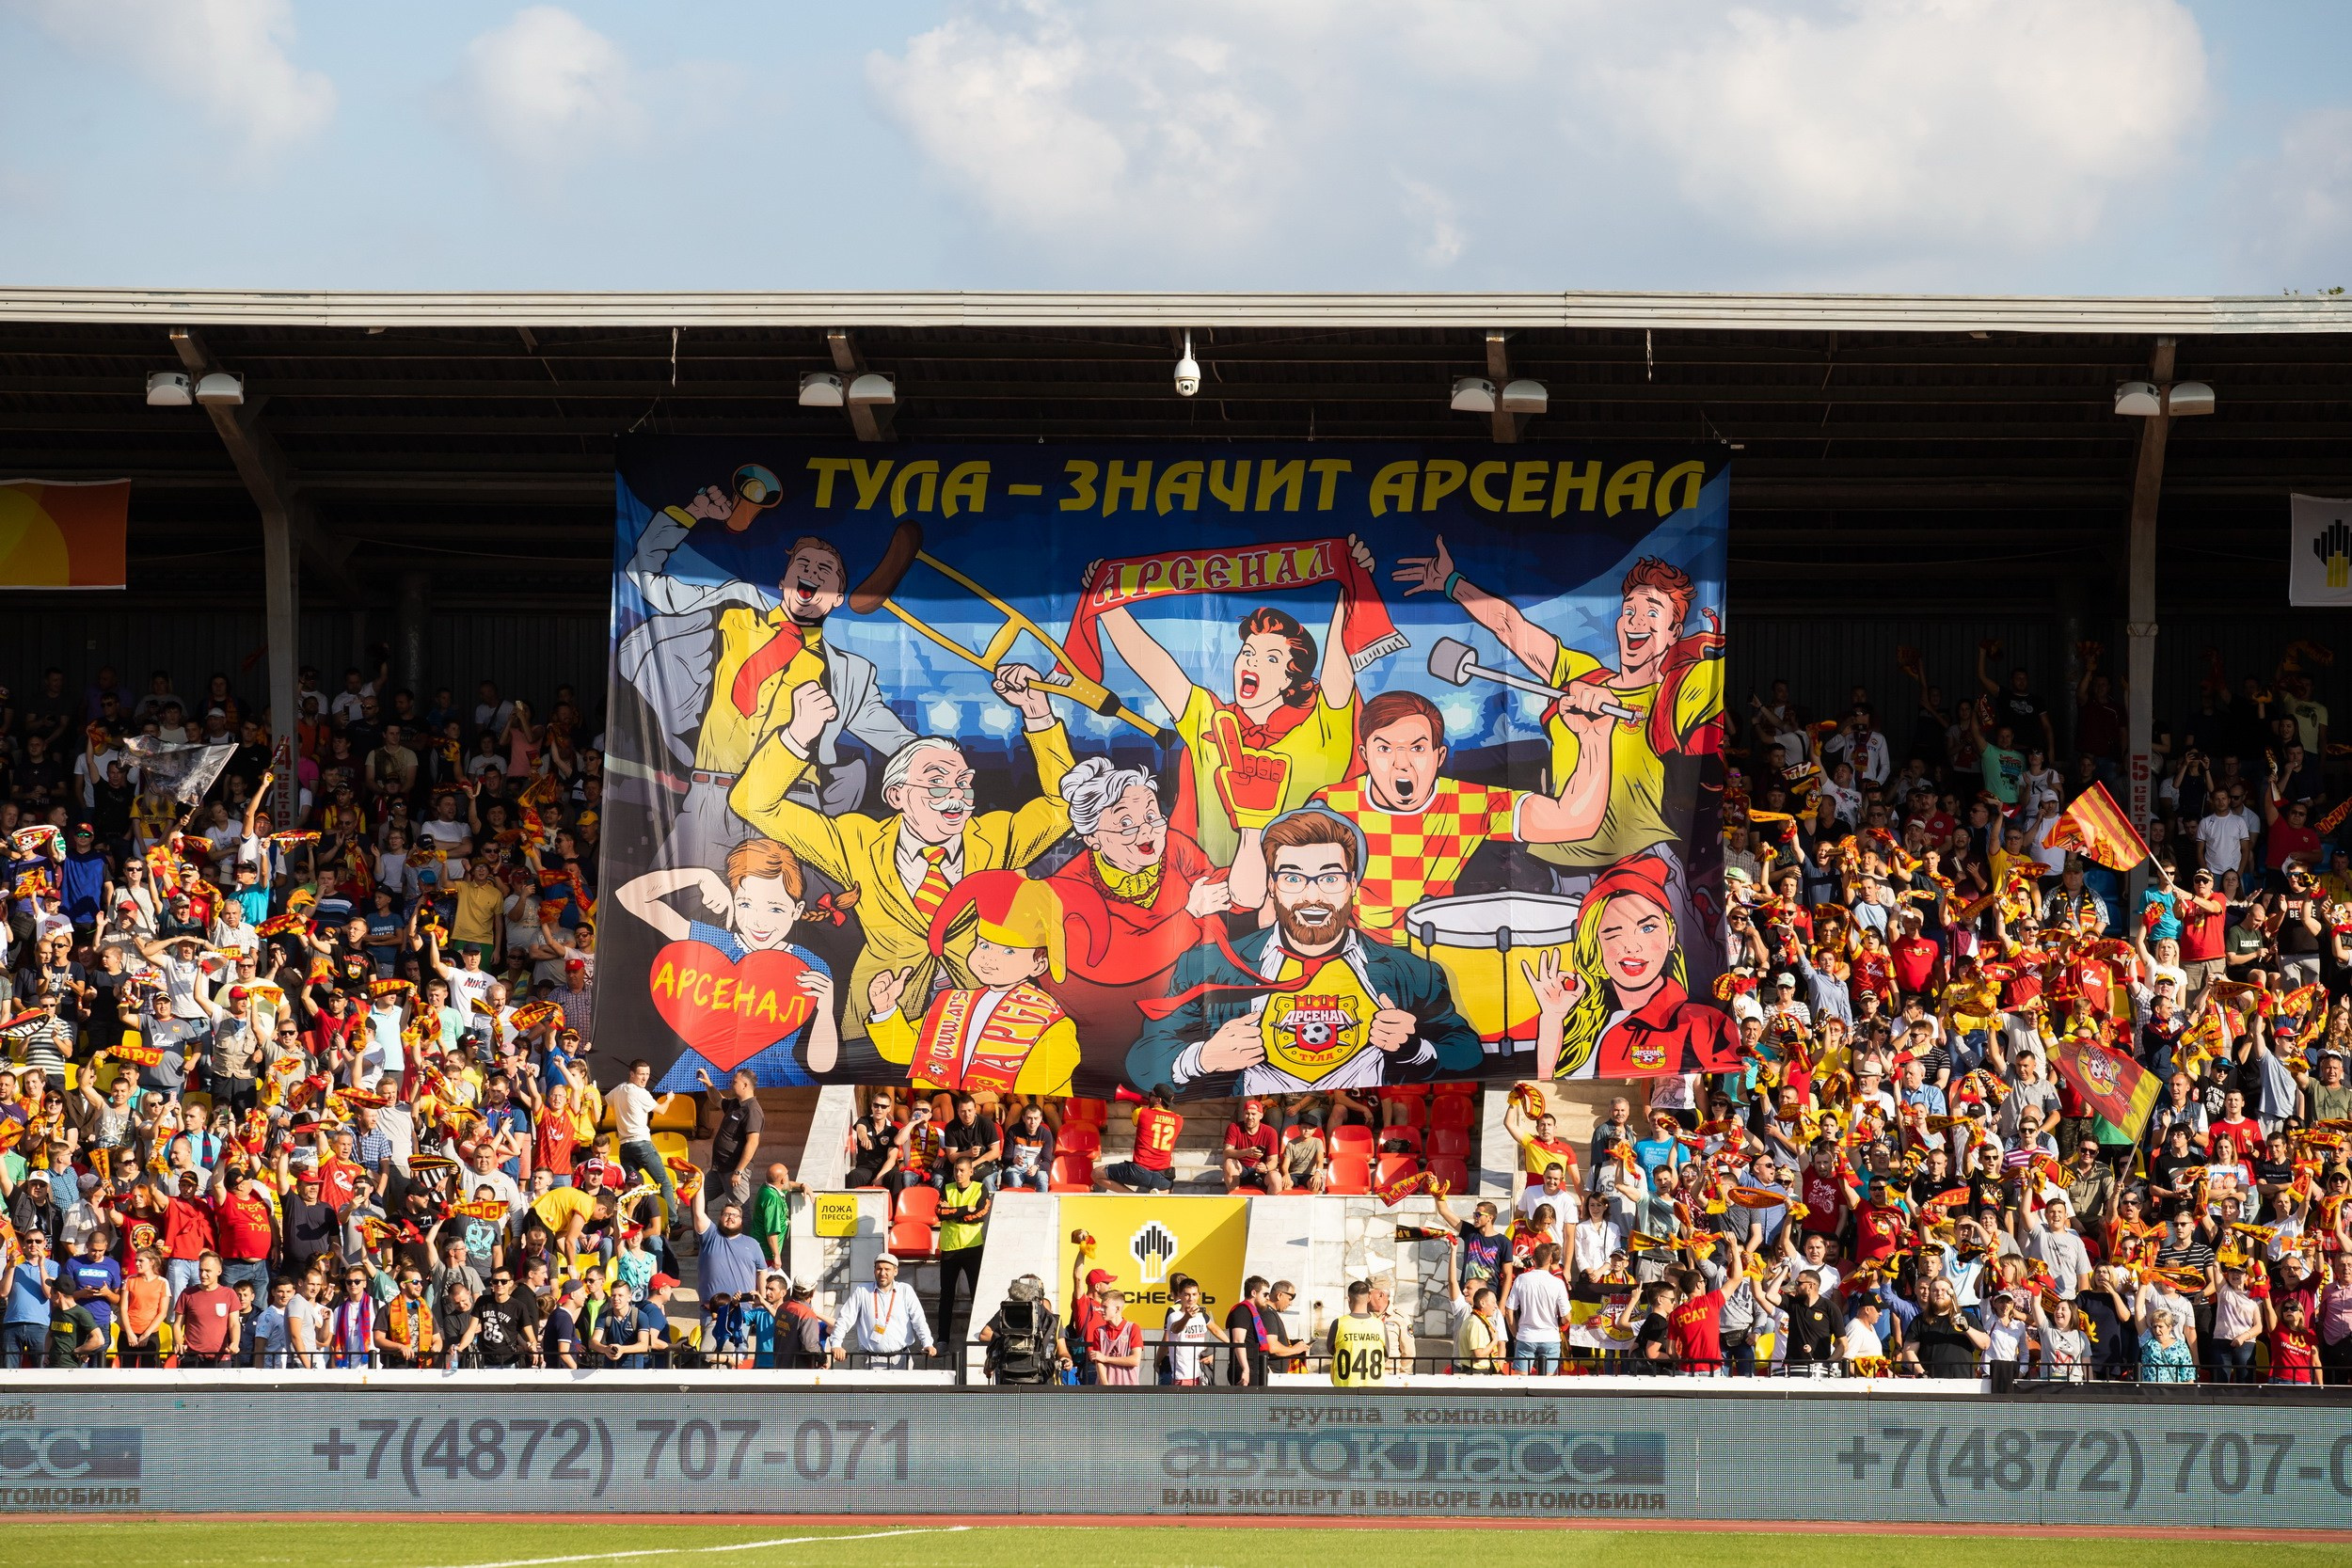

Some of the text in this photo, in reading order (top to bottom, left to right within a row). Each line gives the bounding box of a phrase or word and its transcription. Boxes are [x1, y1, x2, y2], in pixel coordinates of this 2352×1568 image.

[805, 456, 992, 519] ТУЛА
[1058, 457, 1352, 518] ЗНАЧИТ
[1368, 457, 1706, 519] АРСЕНАЛ
[278, 773, 292, 828] СЕКТОР
[464, 976, 487, 990] NIKE
[652, 960, 806, 1026] АРСЕНАЛ
[1279, 1008, 1353, 1026] АРСЕНАЛ
[1298, 1052, 1335, 1063] ТУЛА
[1152, 1123, 1176, 1151] 12
[821, 1200, 852, 1213] ЛОЖА
[79, 1268, 108, 1277] adidas
[1676, 1306, 1709, 1327] FCAT
[1343, 1333, 1380, 1342] STEWARD
[2280, 1341, 2312, 1355] Weekend
[1337, 1348, 1383, 1381] 048
[1268, 1404, 1559, 1429] группа компаний
[312, 1417, 910, 1497] +7(4872) 707-071
[1160, 1429, 1617, 1483] автокласс
[1836, 1426, 2145, 1510] +7(4872)
[1162, 1488, 1666, 1511] ВАШ ЭКСПЕРТ В ВЫБОРЕ АВТОМОБИЛЯ
